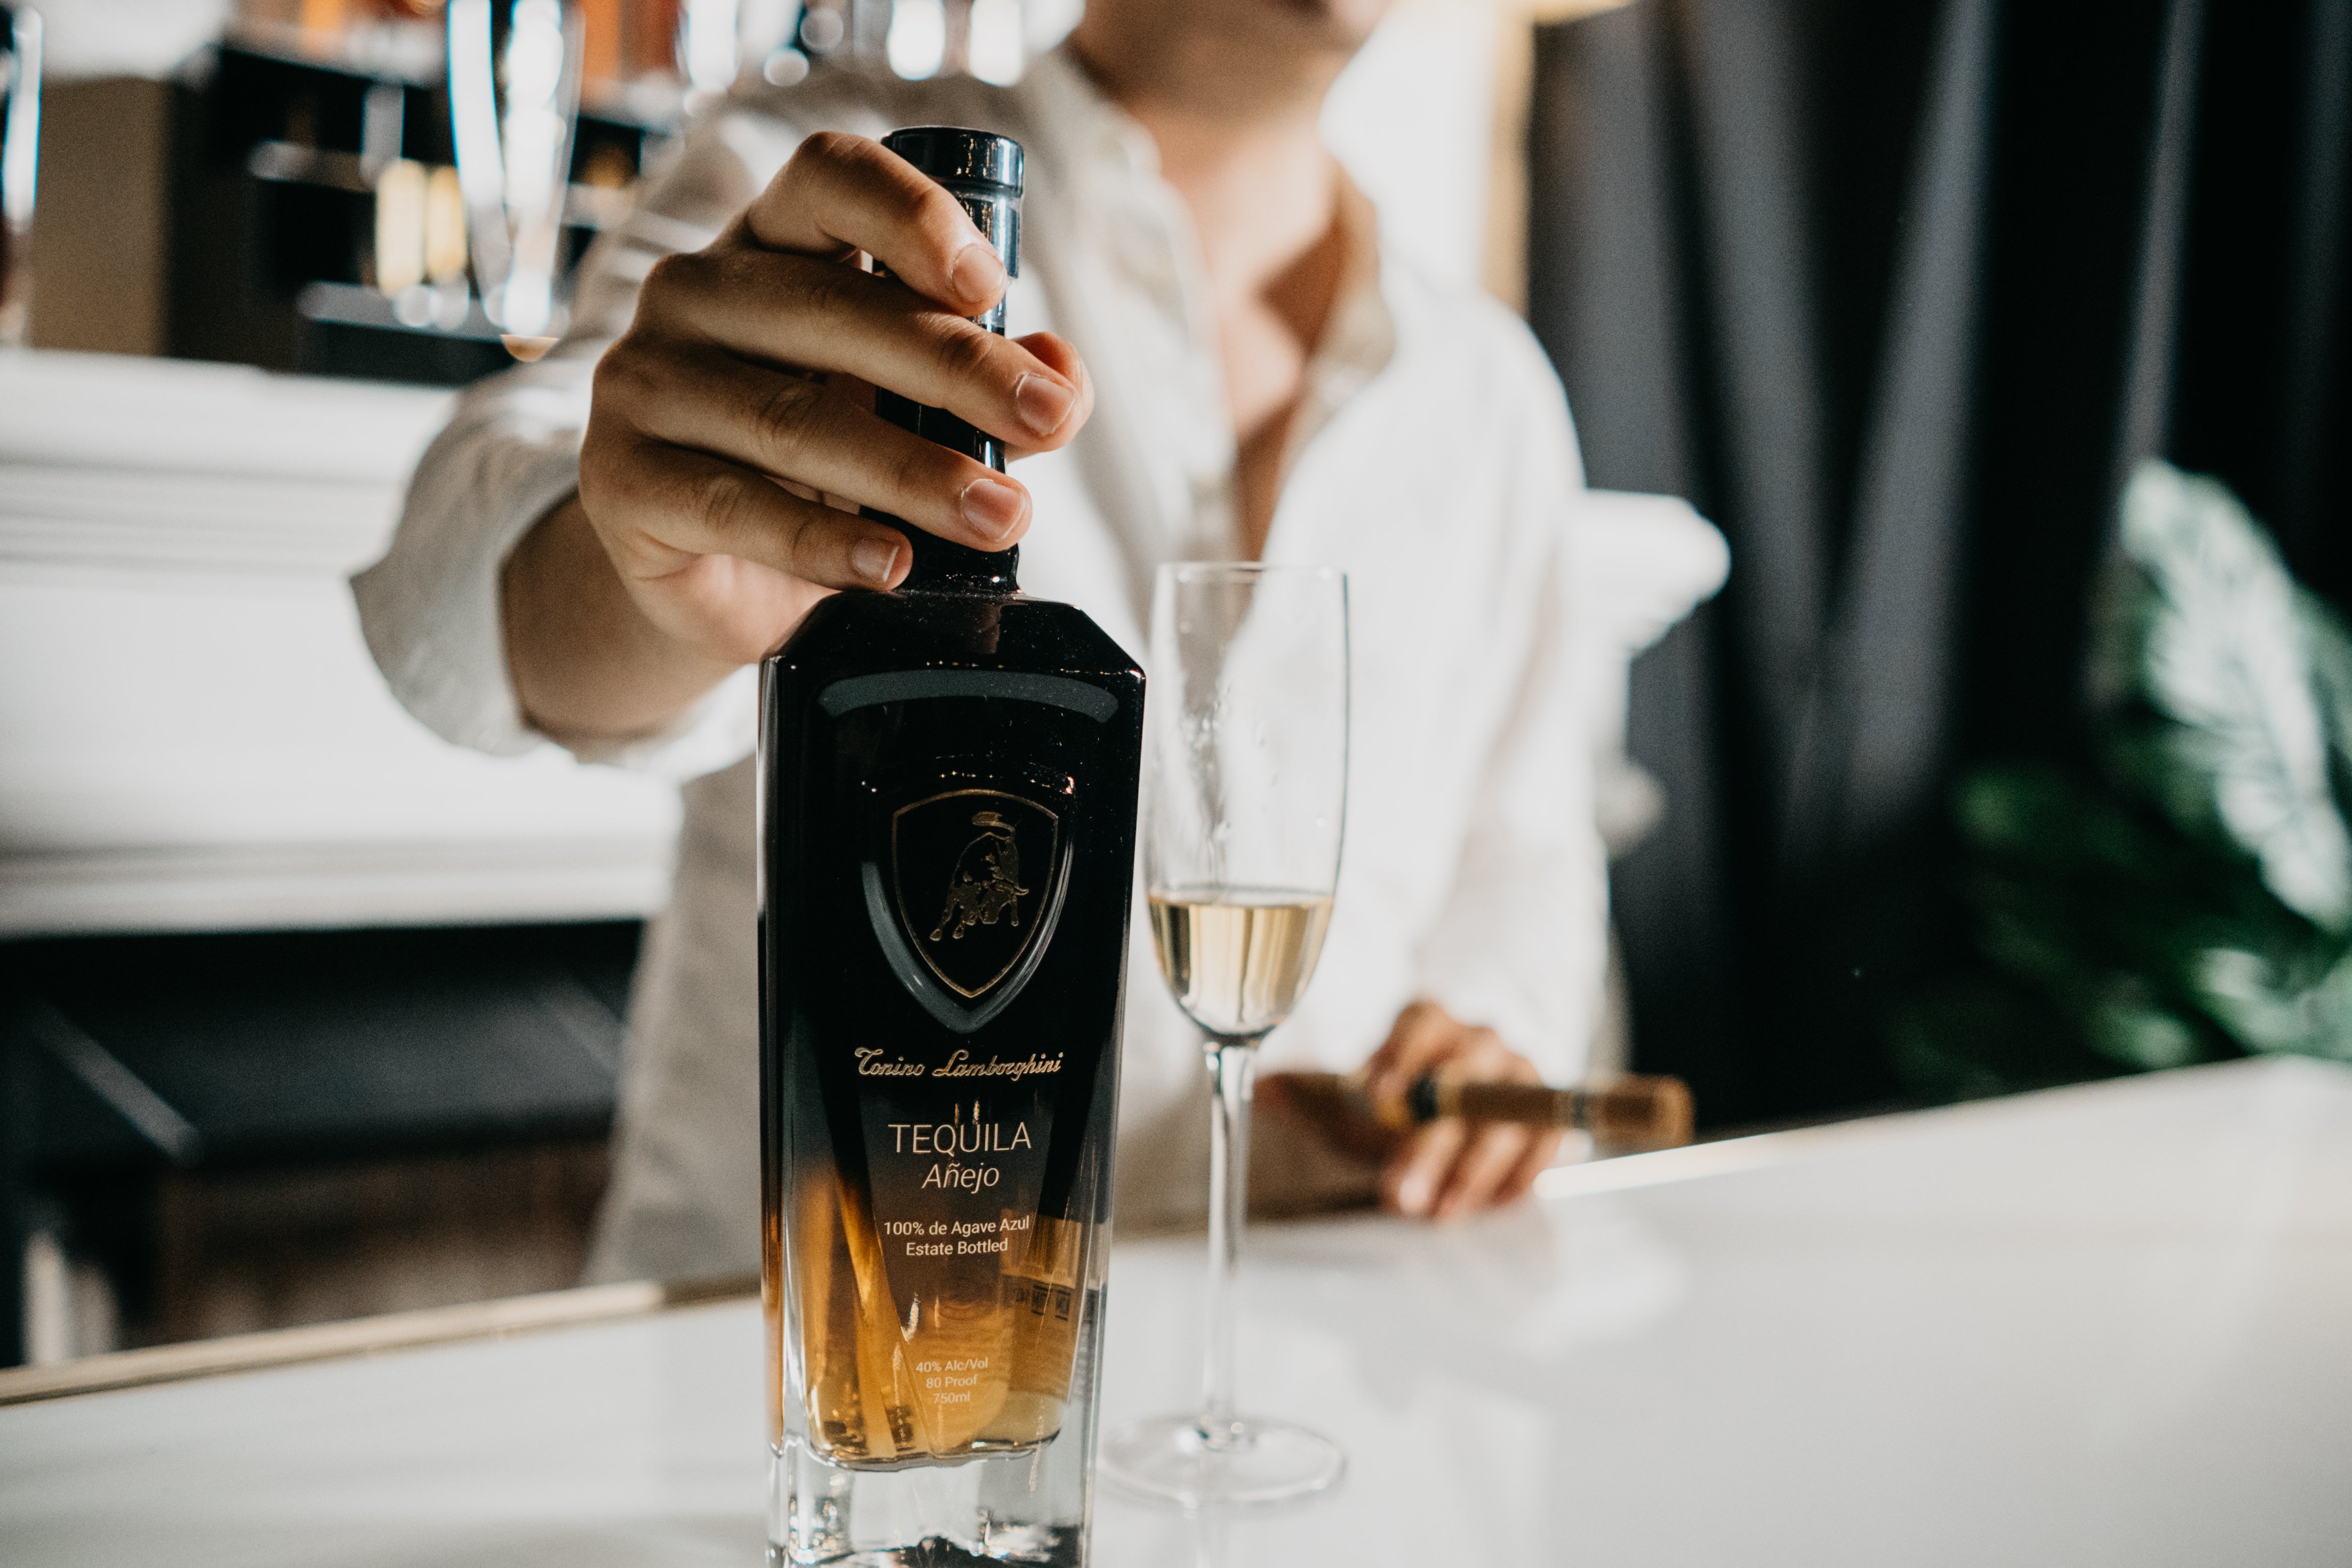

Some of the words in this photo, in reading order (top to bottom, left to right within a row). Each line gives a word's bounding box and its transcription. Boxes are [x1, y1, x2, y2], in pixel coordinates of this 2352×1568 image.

[854, 1047, 925, 1076] Tonino
[932, 1049, 1064, 1081] Lamborghini
[888, 1122, 1032, 1157] TEQUILA
[921, 1163, 999, 1194] Añejo
[884, 1221, 925, 1236] 100%
[929, 1221, 948, 1235] de
[951, 1220, 997, 1237] Agave
[999, 1215, 1030, 1231] Azul
[905, 1241, 953, 1256] Estate
[957, 1239, 1008, 1255] Bottled
[916, 1361, 942, 1373] 40%
[944, 1357, 989, 1371] Alc/Vol
[926, 1376, 942, 1389] 80
[945, 1374, 978, 1387] Proof
[932, 1390, 971, 1405] 750ml
